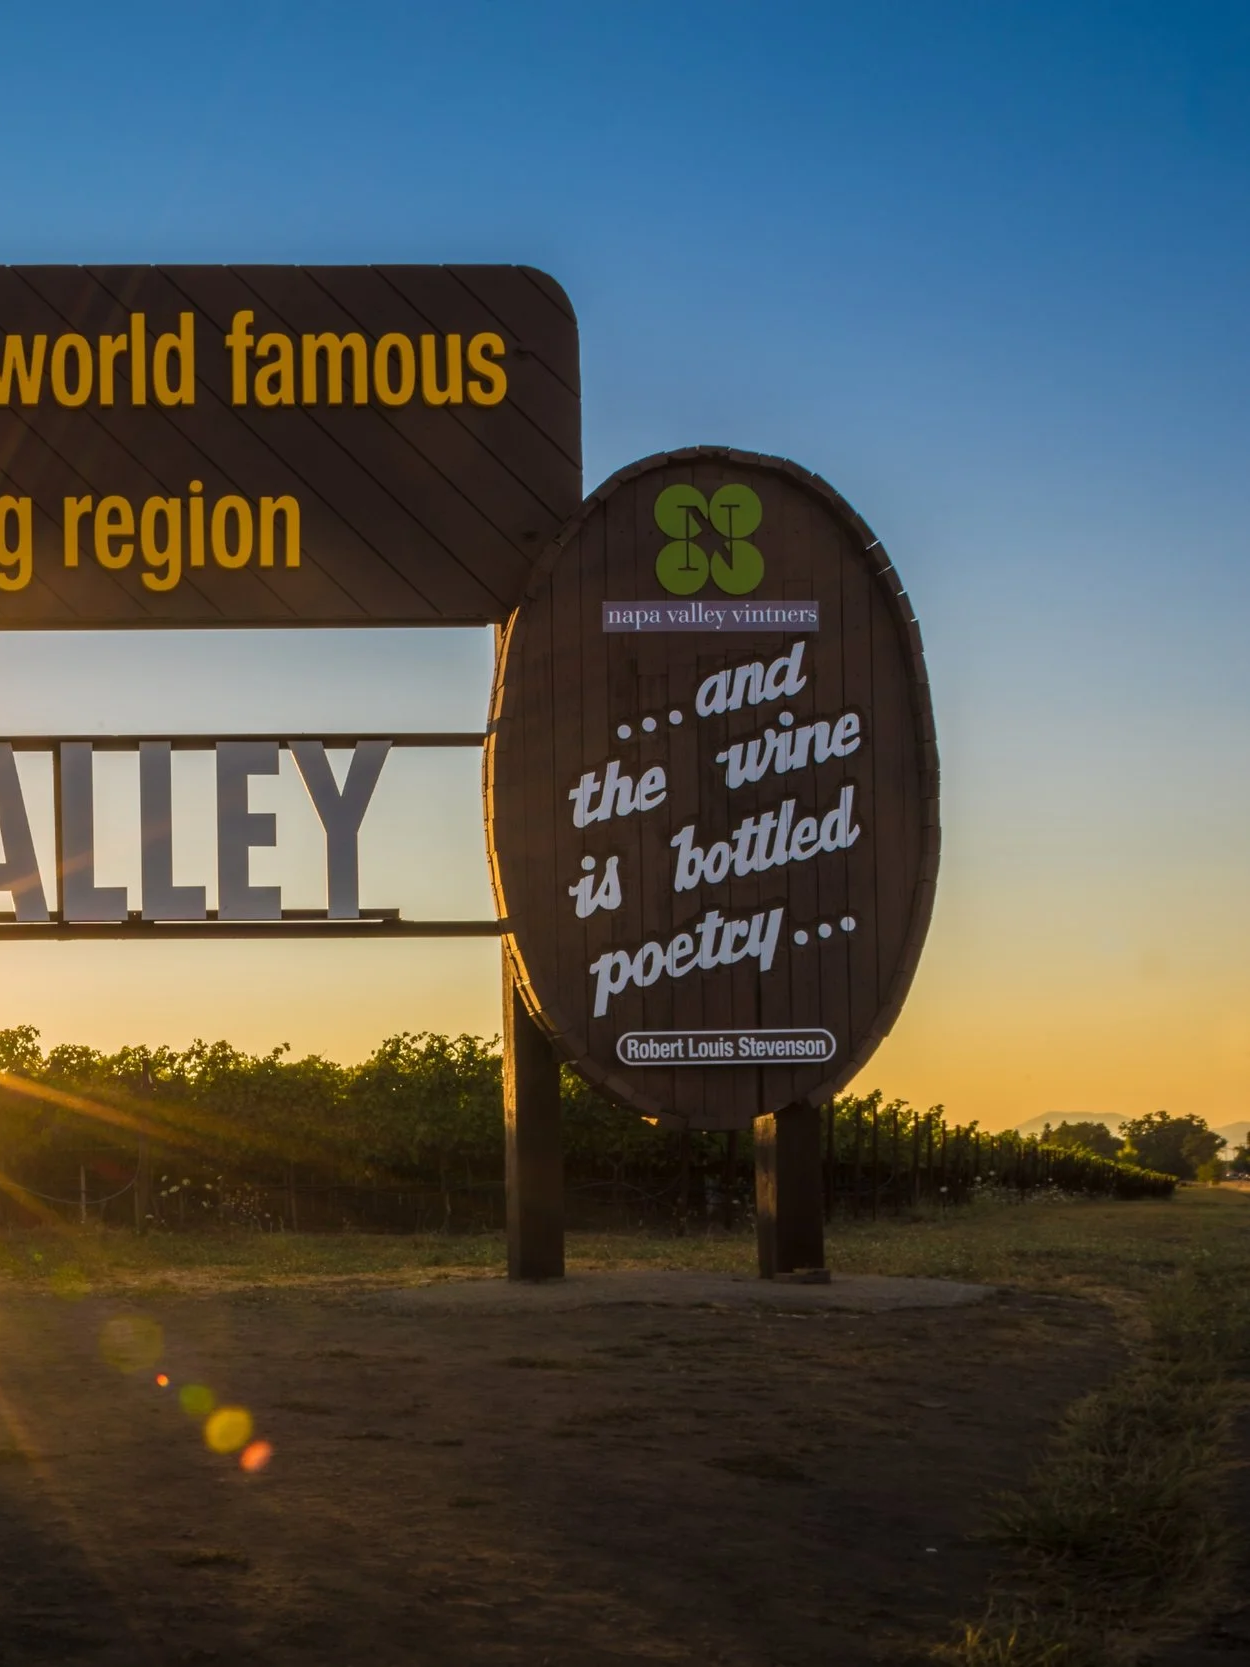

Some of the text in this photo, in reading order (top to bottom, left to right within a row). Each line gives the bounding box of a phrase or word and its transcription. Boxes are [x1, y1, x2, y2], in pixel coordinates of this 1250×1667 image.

[226, 310, 508, 408] famous
[63, 479, 301, 591] region
[607, 603, 817, 630] napa valley vintners
[569, 711, 861, 829] the wine
[568, 785, 860, 919] is bottled
[626, 1033, 827, 1059] Robert Louis Stevenson
